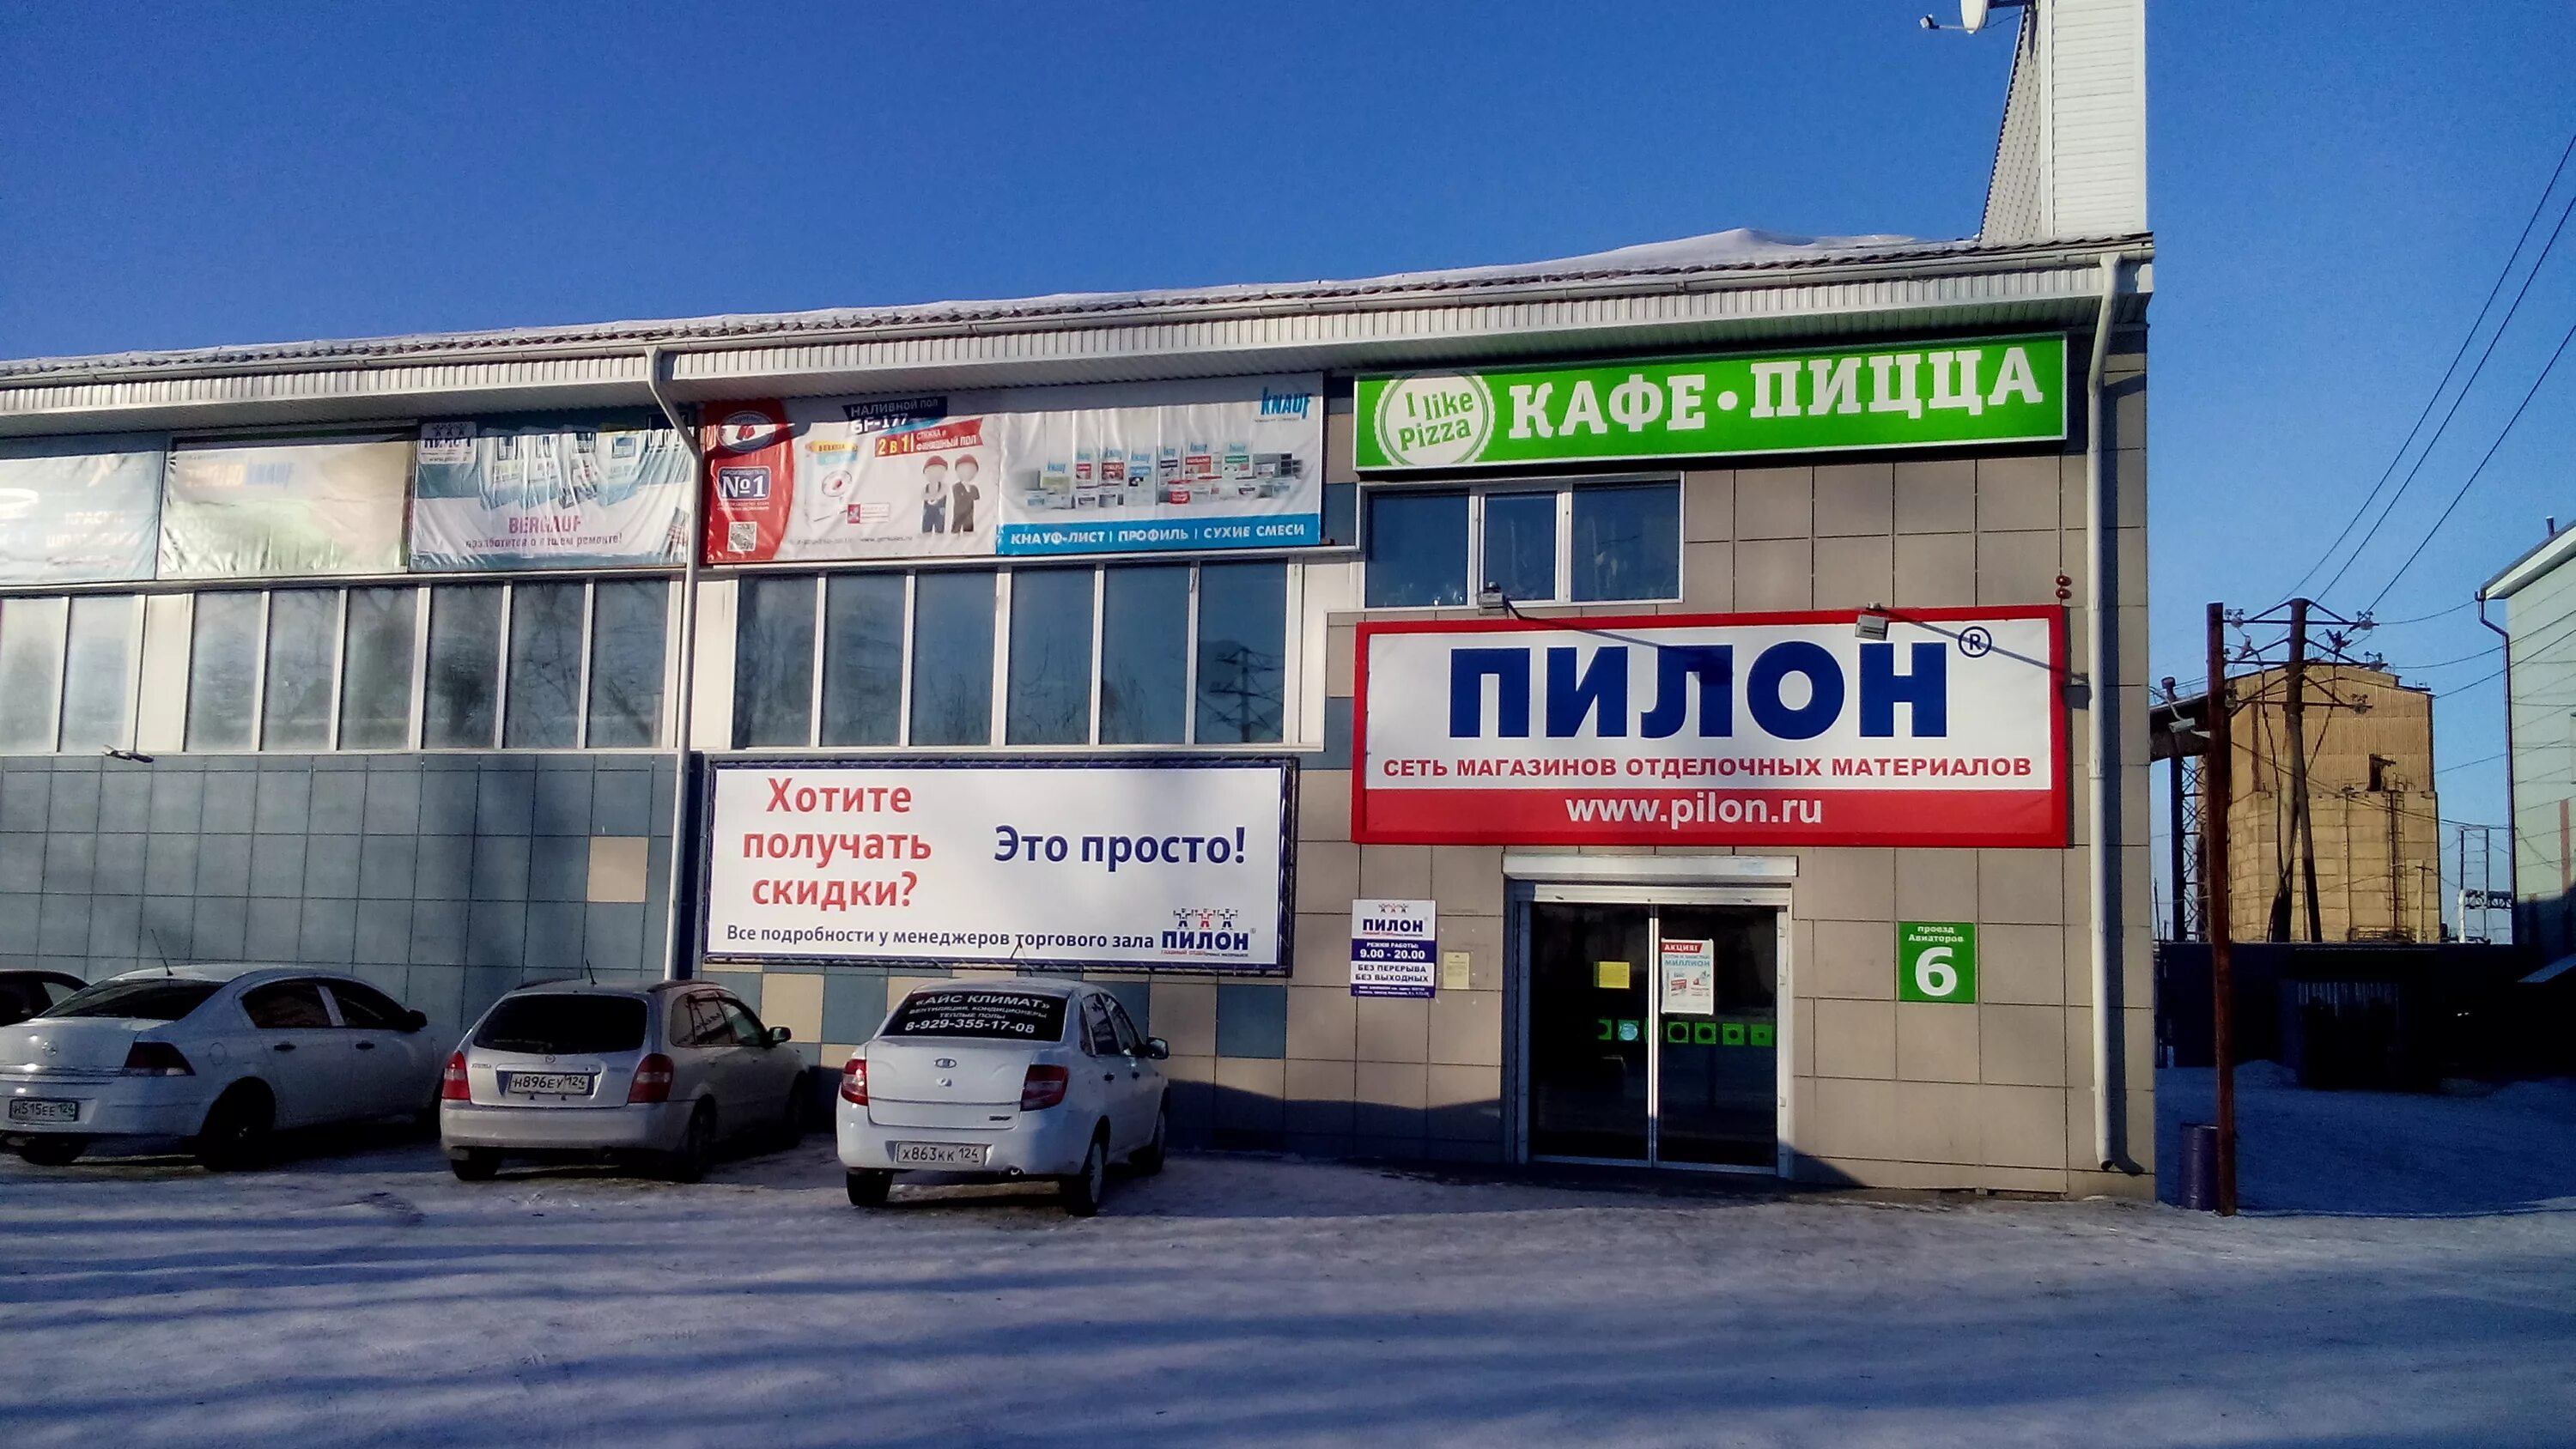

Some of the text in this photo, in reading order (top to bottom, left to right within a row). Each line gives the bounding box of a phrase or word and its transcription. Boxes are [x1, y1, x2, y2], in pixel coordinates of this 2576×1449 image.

[1509, 347, 2043, 439] КАФЕ ПИЦЦА
[851, 400, 918, 417] НАЛИВНОЙ
[1406, 391, 1473, 421] I like
[878, 438, 886, 455] 2
[902, 435, 908, 452] 1
[960, 435, 977, 446] ПОЛ
[1011, 524, 1304, 545] КНАУФ-ЛИСТ ПРОФИЛЬ СУХИЕ СМЕСИ
[1449, 641, 1947, 741] ПИЛОН
[1383, 756, 2032, 779] СЕТЬ МАГАЗИНОВ ОТДЕЛОЧНЫХ МАТЕРИАЛОВ
[766, 777, 912, 813] Хотите
[1565, 791, 1822, 830] www.pilon.ru
[743, 833, 932, 869] получать
[994, 825, 1247, 872] Это просто!
[752, 870, 918, 912] скидки?
[1363, 918, 1424, 932] ПИЛОН
[1917, 925, 1954, 934] проезд
[726, 925, 1155, 949] Все подробности у менеджеров торгового зала
[1162, 931, 1249, 950] ПИЛОН
[1908, 933, 1964, 943] Авиаторов
[1360, 949, 1384, 958] 9.00
[1394, 949, 1425, 960] 20.00
[1375, 973, 1429, 982] ВЫХОДНЫХ
[1915, 946, 1957, 997] 6
[967, 995, 1050, 1009] КЛИМАТ»
[905, 1019, 1036, 1034] 8-929-355-17-08
